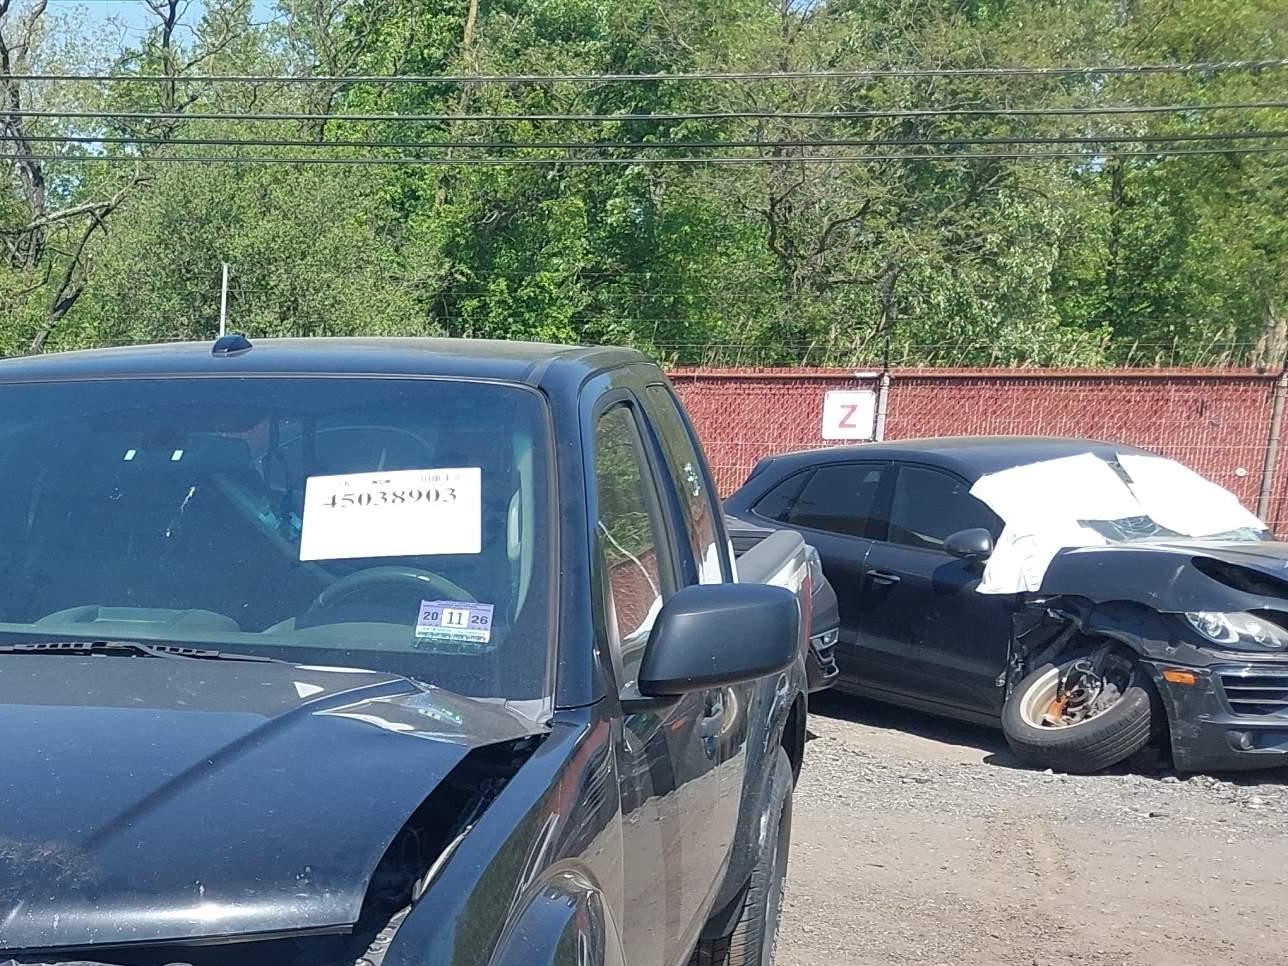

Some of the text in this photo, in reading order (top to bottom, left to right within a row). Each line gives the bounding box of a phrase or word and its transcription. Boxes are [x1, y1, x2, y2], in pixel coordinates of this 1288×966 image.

[838, 404, 858, 429] Z
[322, 487, 458, 509] 45038903
[423, 611, 489, 626] 20 11 26
